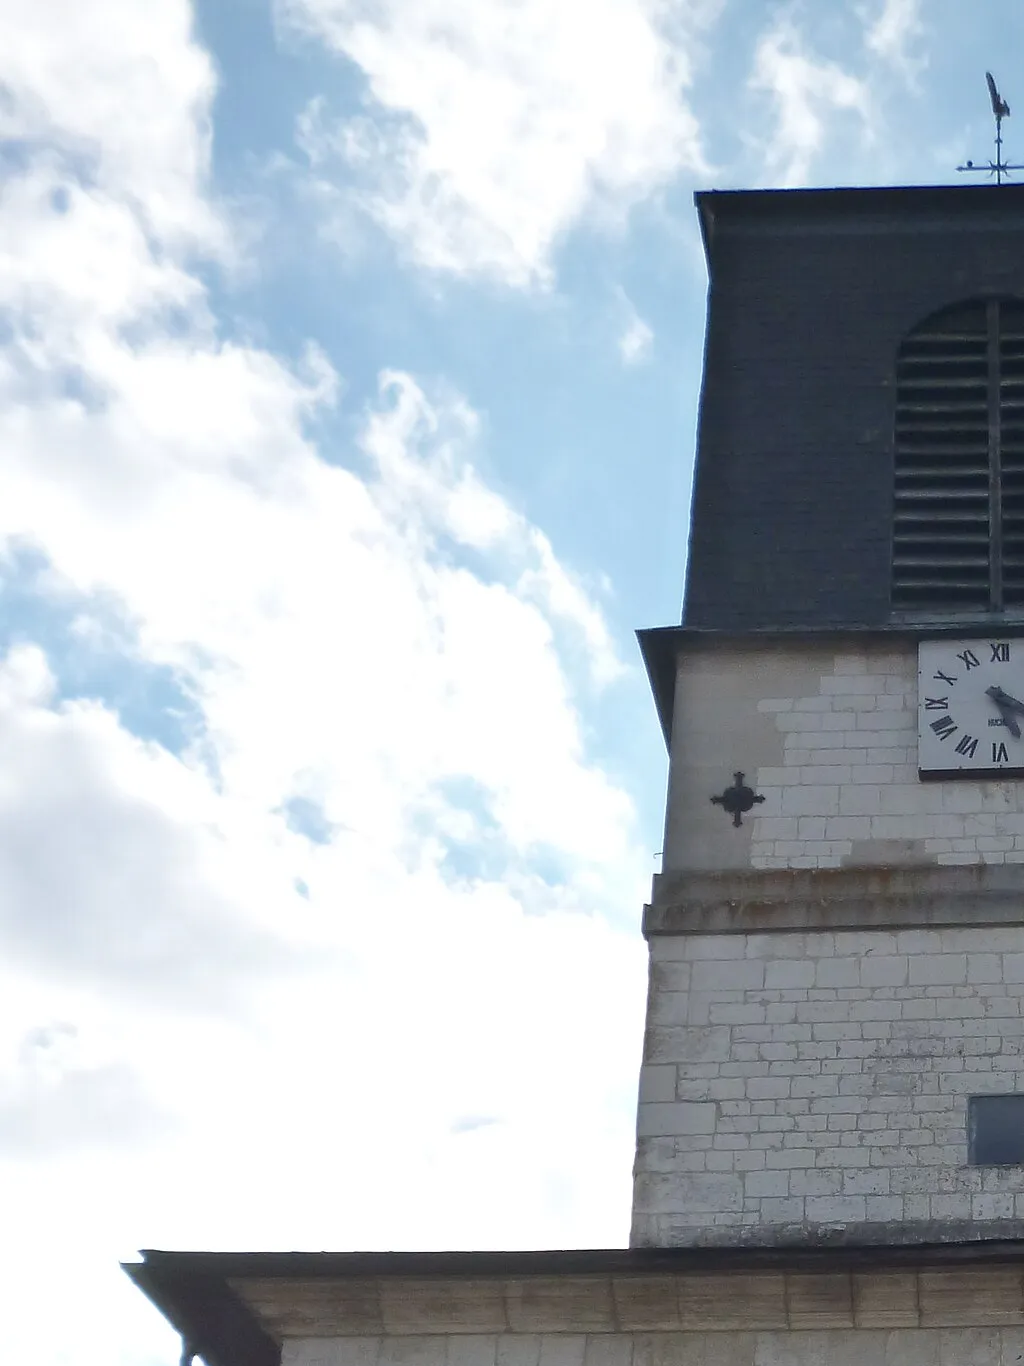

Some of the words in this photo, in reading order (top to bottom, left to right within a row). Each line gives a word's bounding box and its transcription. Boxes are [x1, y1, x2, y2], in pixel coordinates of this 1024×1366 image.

[956, 649, 981, 671] XI
[990, 643, 1010, 662] XII
[933, 670, 958, 686] X
